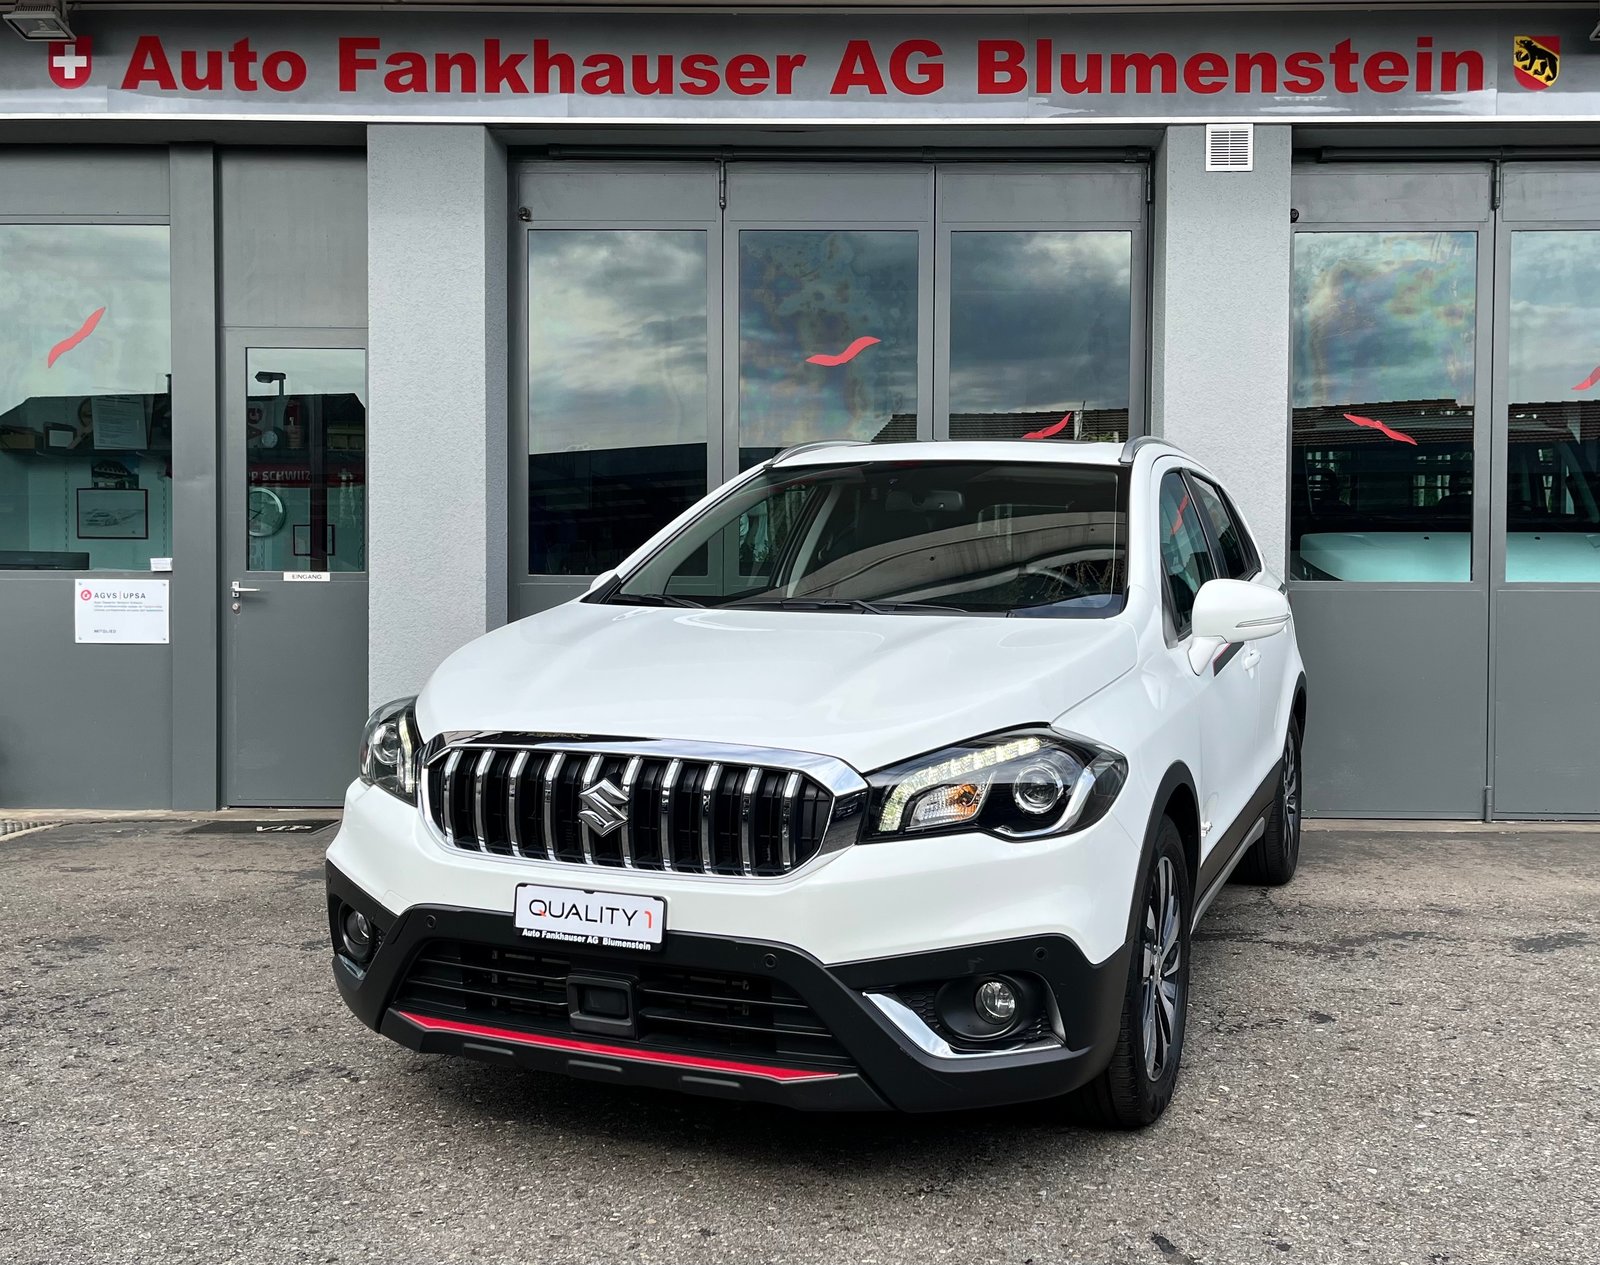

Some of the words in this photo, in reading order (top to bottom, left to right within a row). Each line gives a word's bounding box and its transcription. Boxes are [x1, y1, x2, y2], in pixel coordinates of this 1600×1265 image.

[121, 36, 307, 90] Auto
[337, 38, 806, 96] Fankhauser
[830, 40, 944, 96] AG
[978, 37, 1484, 95] Blumenstein
[529, 899, 638, 927] QUALITY
[644, 910, 653, 929] 1
[522, 928, 541, 938] Auto
[541, 931, 586, 943] Fankhauser
[586, 936, 599, 945] AG
[602, 937, 651, 951] Blumenstein
